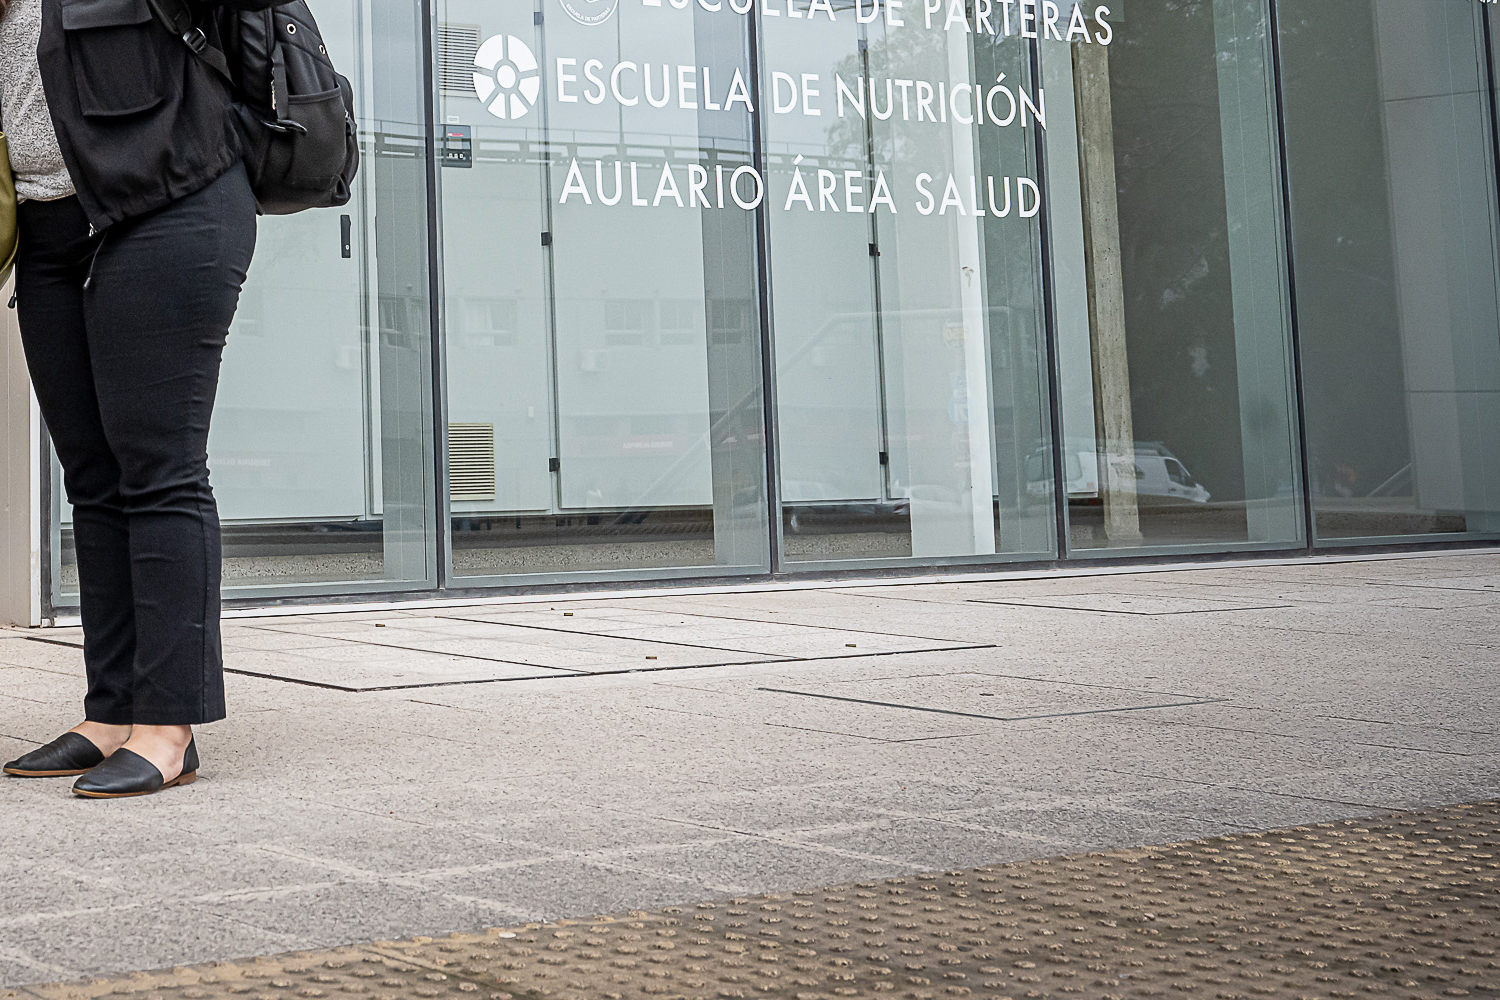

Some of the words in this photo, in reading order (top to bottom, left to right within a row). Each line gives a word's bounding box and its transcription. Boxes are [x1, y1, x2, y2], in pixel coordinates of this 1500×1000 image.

[555, 57, 754, 113] ESCUELA
[772, 71, 822, 116] DE
[836, 72, 1047, 131] NUTRICIÓN
[558, 155, 764, 210] AULARIO
[784, 153, 898, 215] ÁREA
[915, 171, 1041, 220] SALUD
